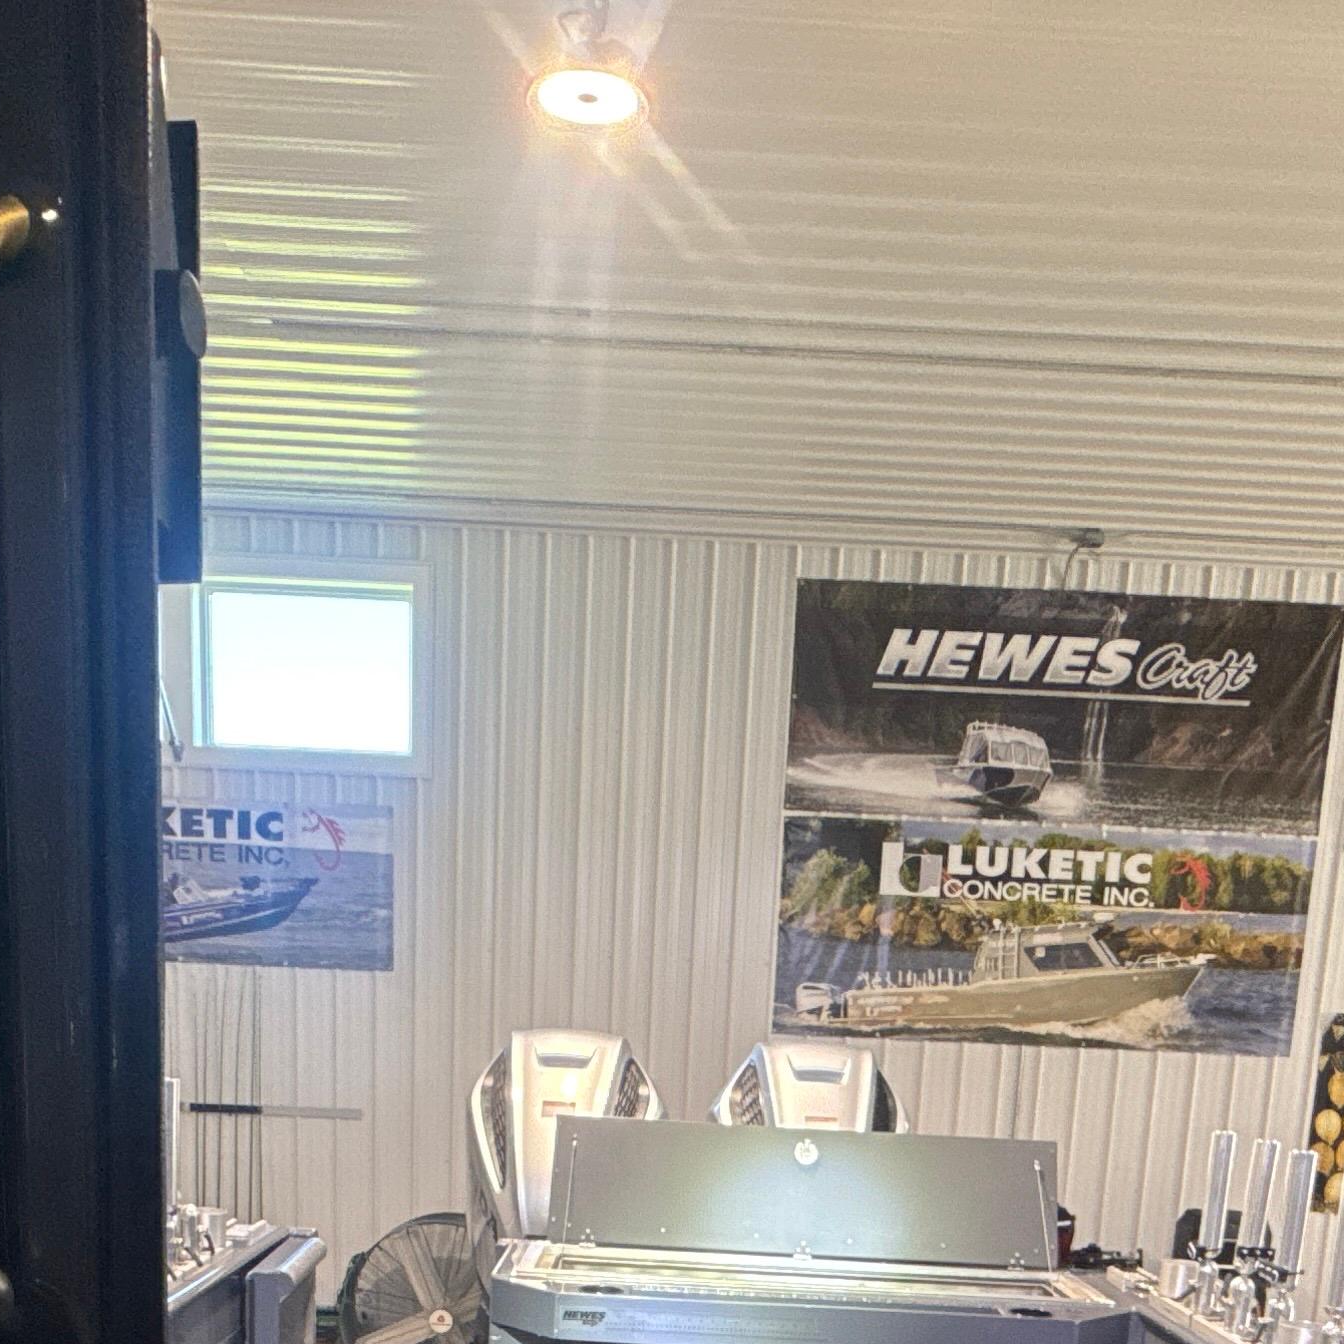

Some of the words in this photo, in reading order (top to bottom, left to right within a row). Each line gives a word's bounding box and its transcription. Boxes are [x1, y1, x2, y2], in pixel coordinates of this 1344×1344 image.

[875, 628, 1141, 687] HEWES
[1135, 642, 1258, 700] Craft
[946, 843, 1154, 885] LUKETIC
[942, 879, 1094, 905] CONCRETE
[1102, 886, 1156, 908] INC.
